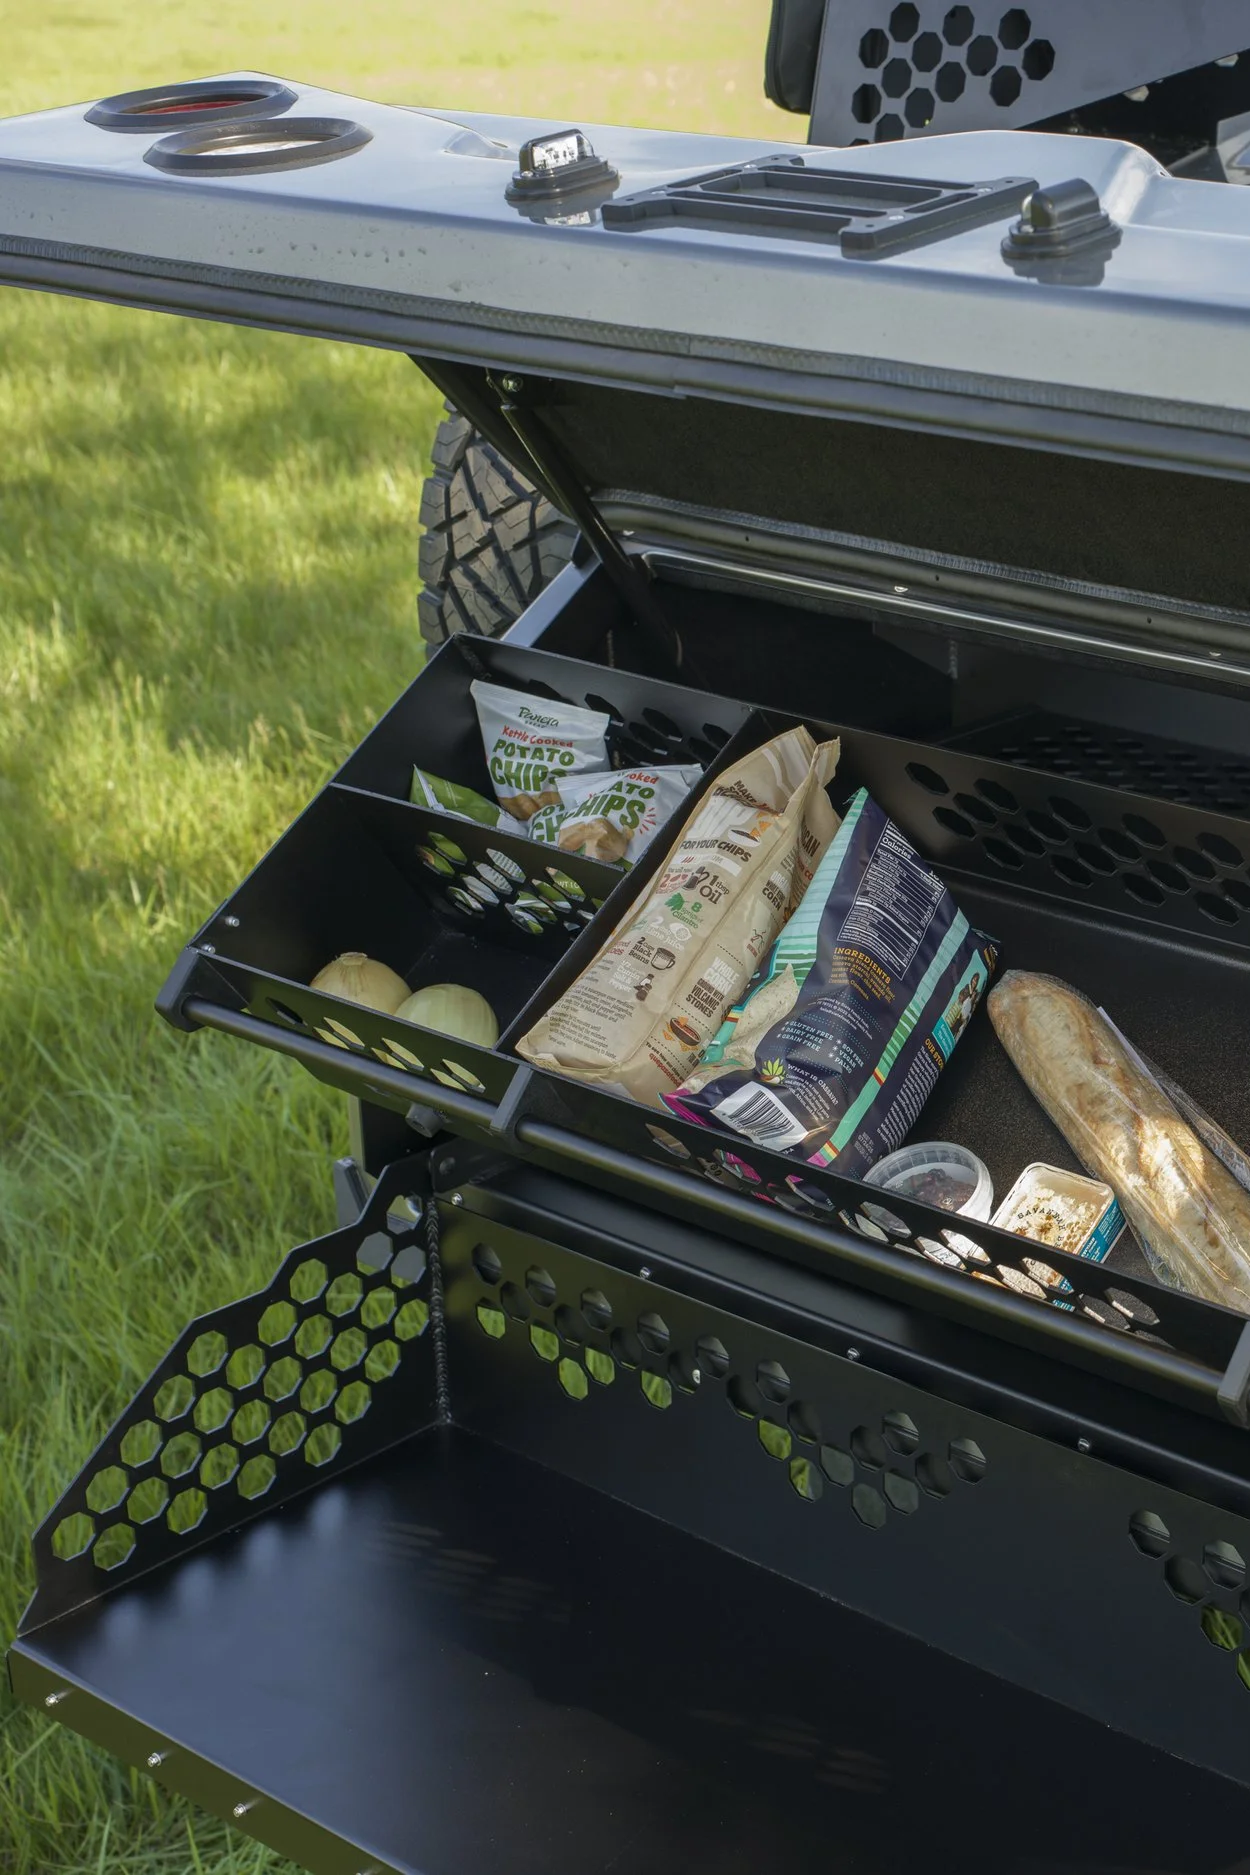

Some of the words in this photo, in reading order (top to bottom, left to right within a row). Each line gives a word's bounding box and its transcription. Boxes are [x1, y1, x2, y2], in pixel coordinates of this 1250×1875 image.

[518, 706, 559, 728] Panera
[502, 725, 529, 742] Kettle
[530, 735, 573, 748] Cooked
[492, 738, 575, 767] POTATO
[627, 770, 660, 785] oked
[608, 781, 655, 799] ATO
[568, 793, 646, 830] HIPS
[680, 840, 697, 850] FOR
[696, 839, 718, 850] YOUR
[717, 841, 752, 863] CHIPS
[882, 836, 912, 859] Calories
[699, 884, 722, 905] Oil
[708, 875, 719, 886] 1
[715, 881, 730, 895] tbsp
[691, 901, 703, 912] 8
[762, 887, 782, 910] CORN
[672, 909, 698, 929] Cilantro
[632, 944, 652, 958] Black
[637, 936, 646, 945] 2
[628, 949, 650, 965] Beans
[834, 947, 891, 984] INGREDIENTS
[712, 956, 740, 985] WHOLE
[703, 967, 734, 996] CORN
[685, 994, 714, 1018] STONES
[692, 983, 719, 1011] VOLCANIC
[785, 1027, 806, 1037] DAIRY
[805, 1033, 824, 1045] FREE
[789, 1020, 816, 1033] GLUTEN
[815, 1027, 834, 1041] FREE
[781, 1033, 803, 1043] GRAIN
[802, 1039, 821, 1052] FREE
[924, 1037, 935, 1054] OUR
[658, 1051, 667, 1060] how
[834, 1057, 853, 1074] PALEO
[839, 1049, 857, 1069] VEGAN
[841, 1043, 854, 1055] SOY
[852, 1052, 865, 1068] FREE
[787, 1063, 810, 1077] WHAT
[817, 1079, 839, 1106] CASSAVA?
